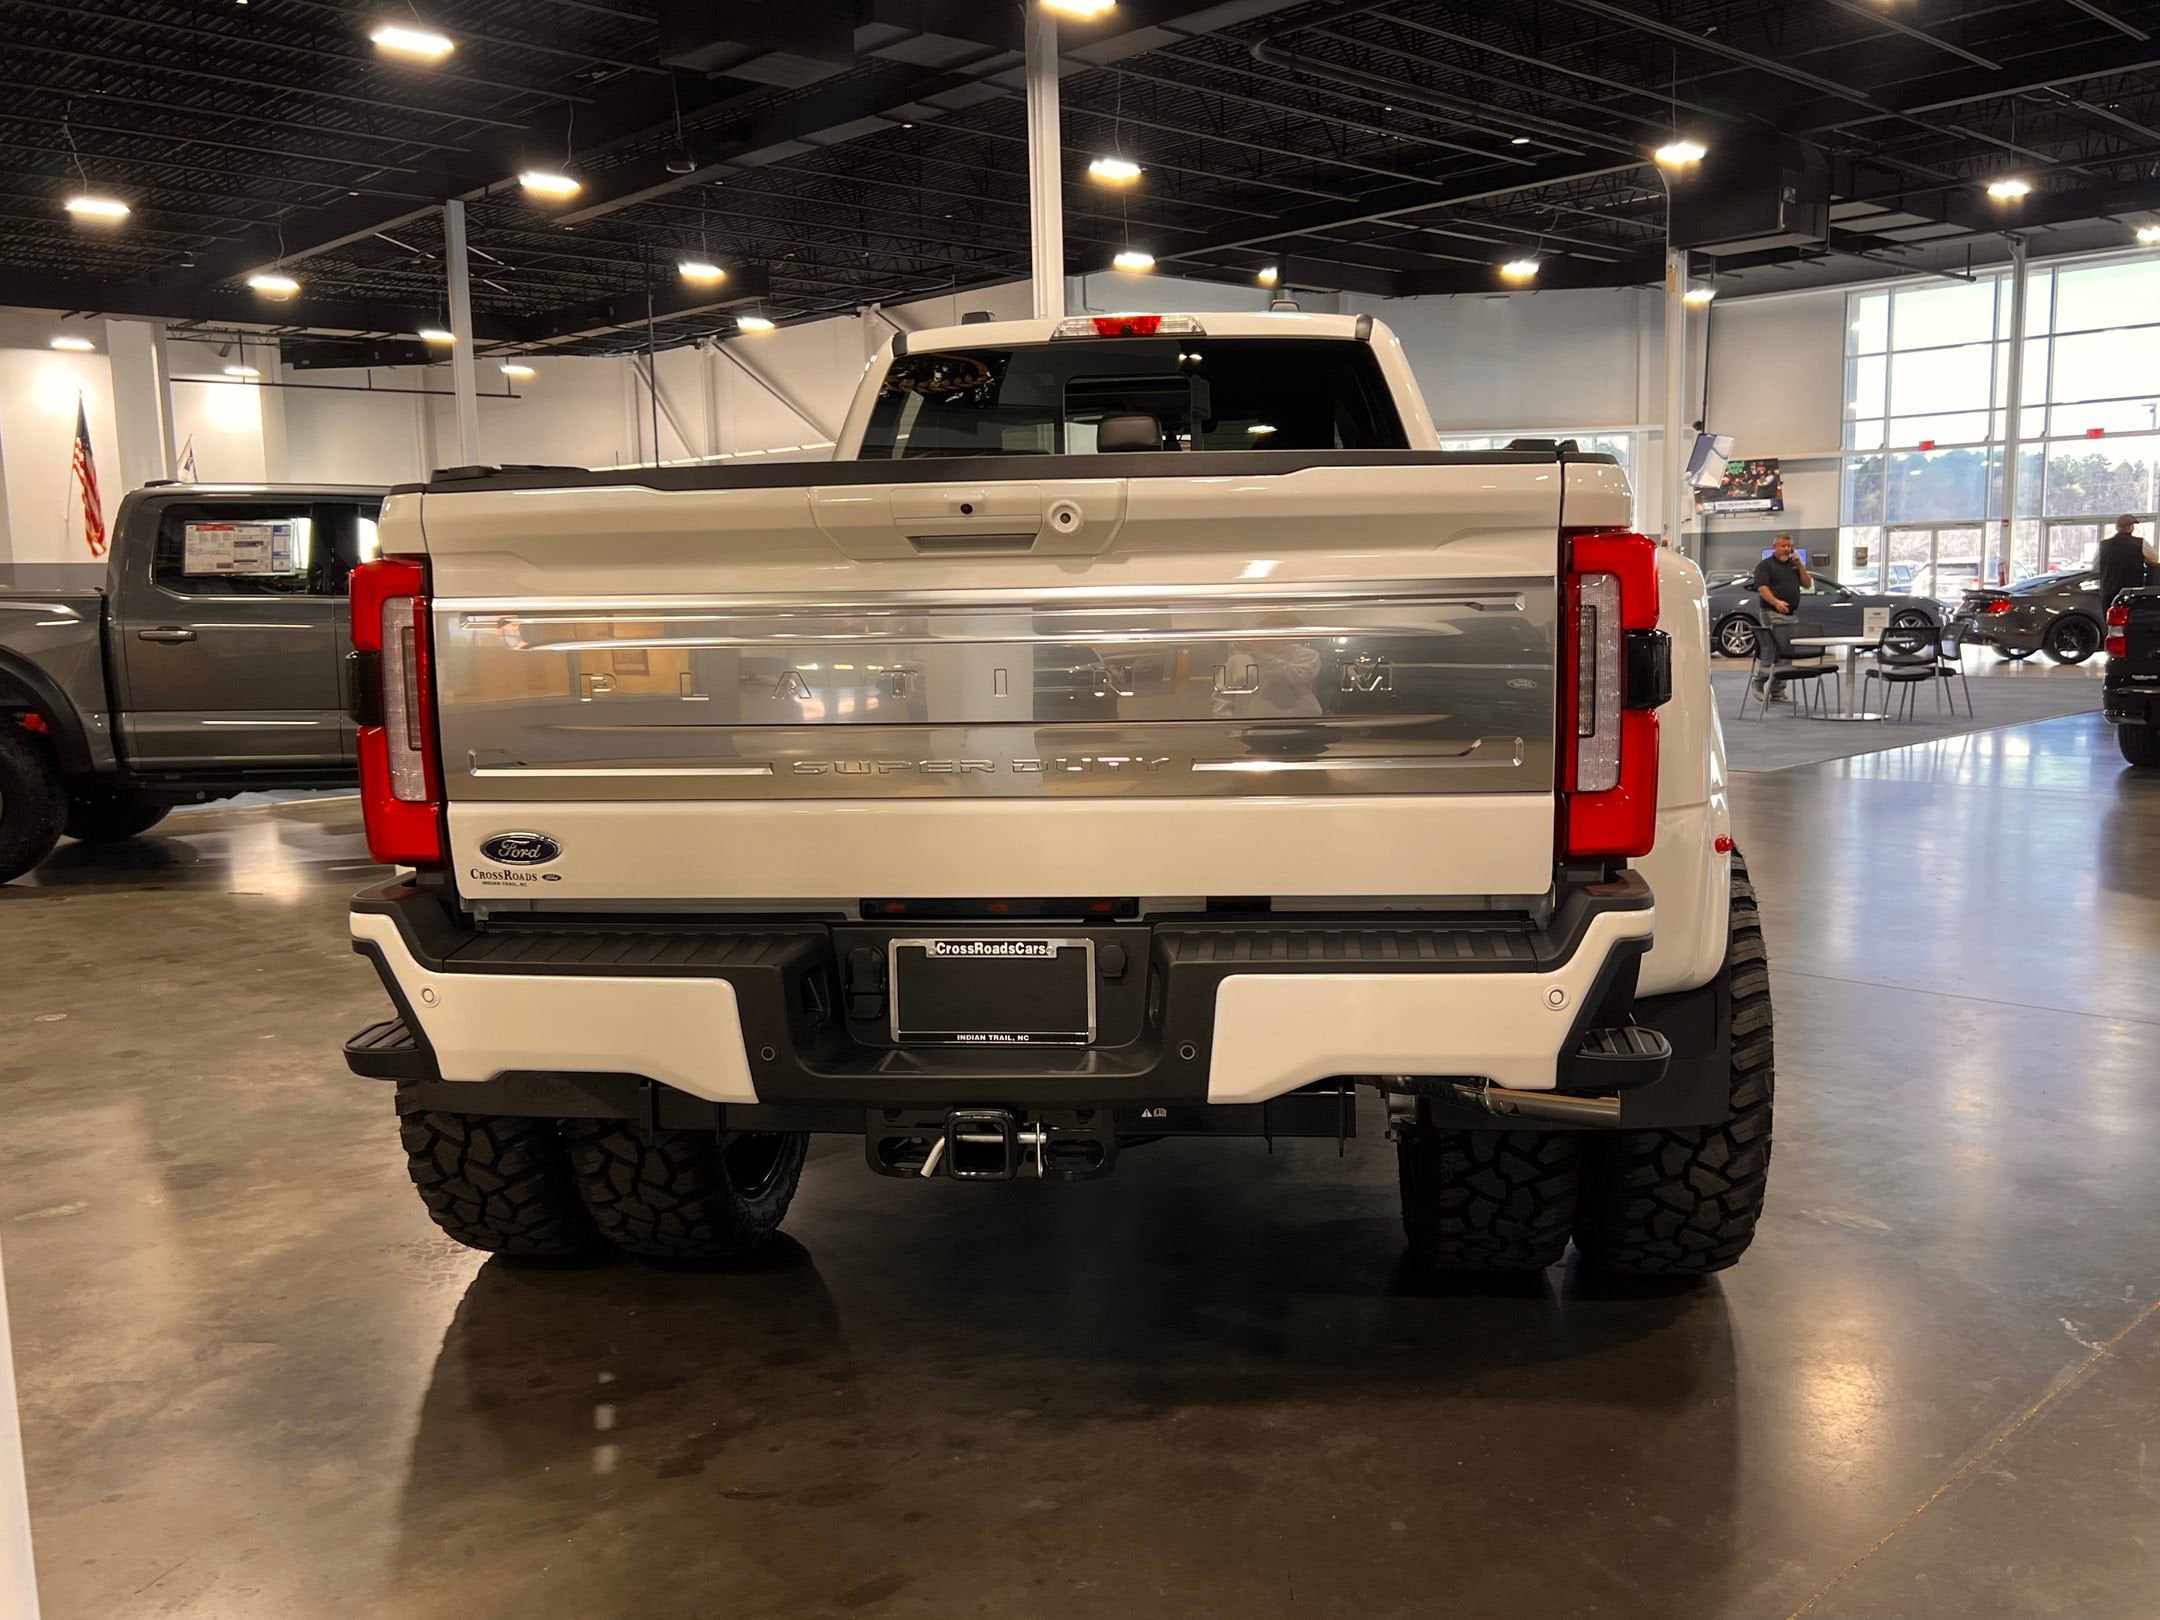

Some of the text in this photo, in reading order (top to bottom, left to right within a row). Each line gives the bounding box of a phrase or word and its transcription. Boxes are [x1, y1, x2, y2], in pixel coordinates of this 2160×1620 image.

[579, 661, 1392, 702] PLATINUM
[793, 757, 1170, 775] SUPER DUTY
[498, 839, 541, 859] Ford
[936, 942, 1046, 955] CrossRoadsCars
